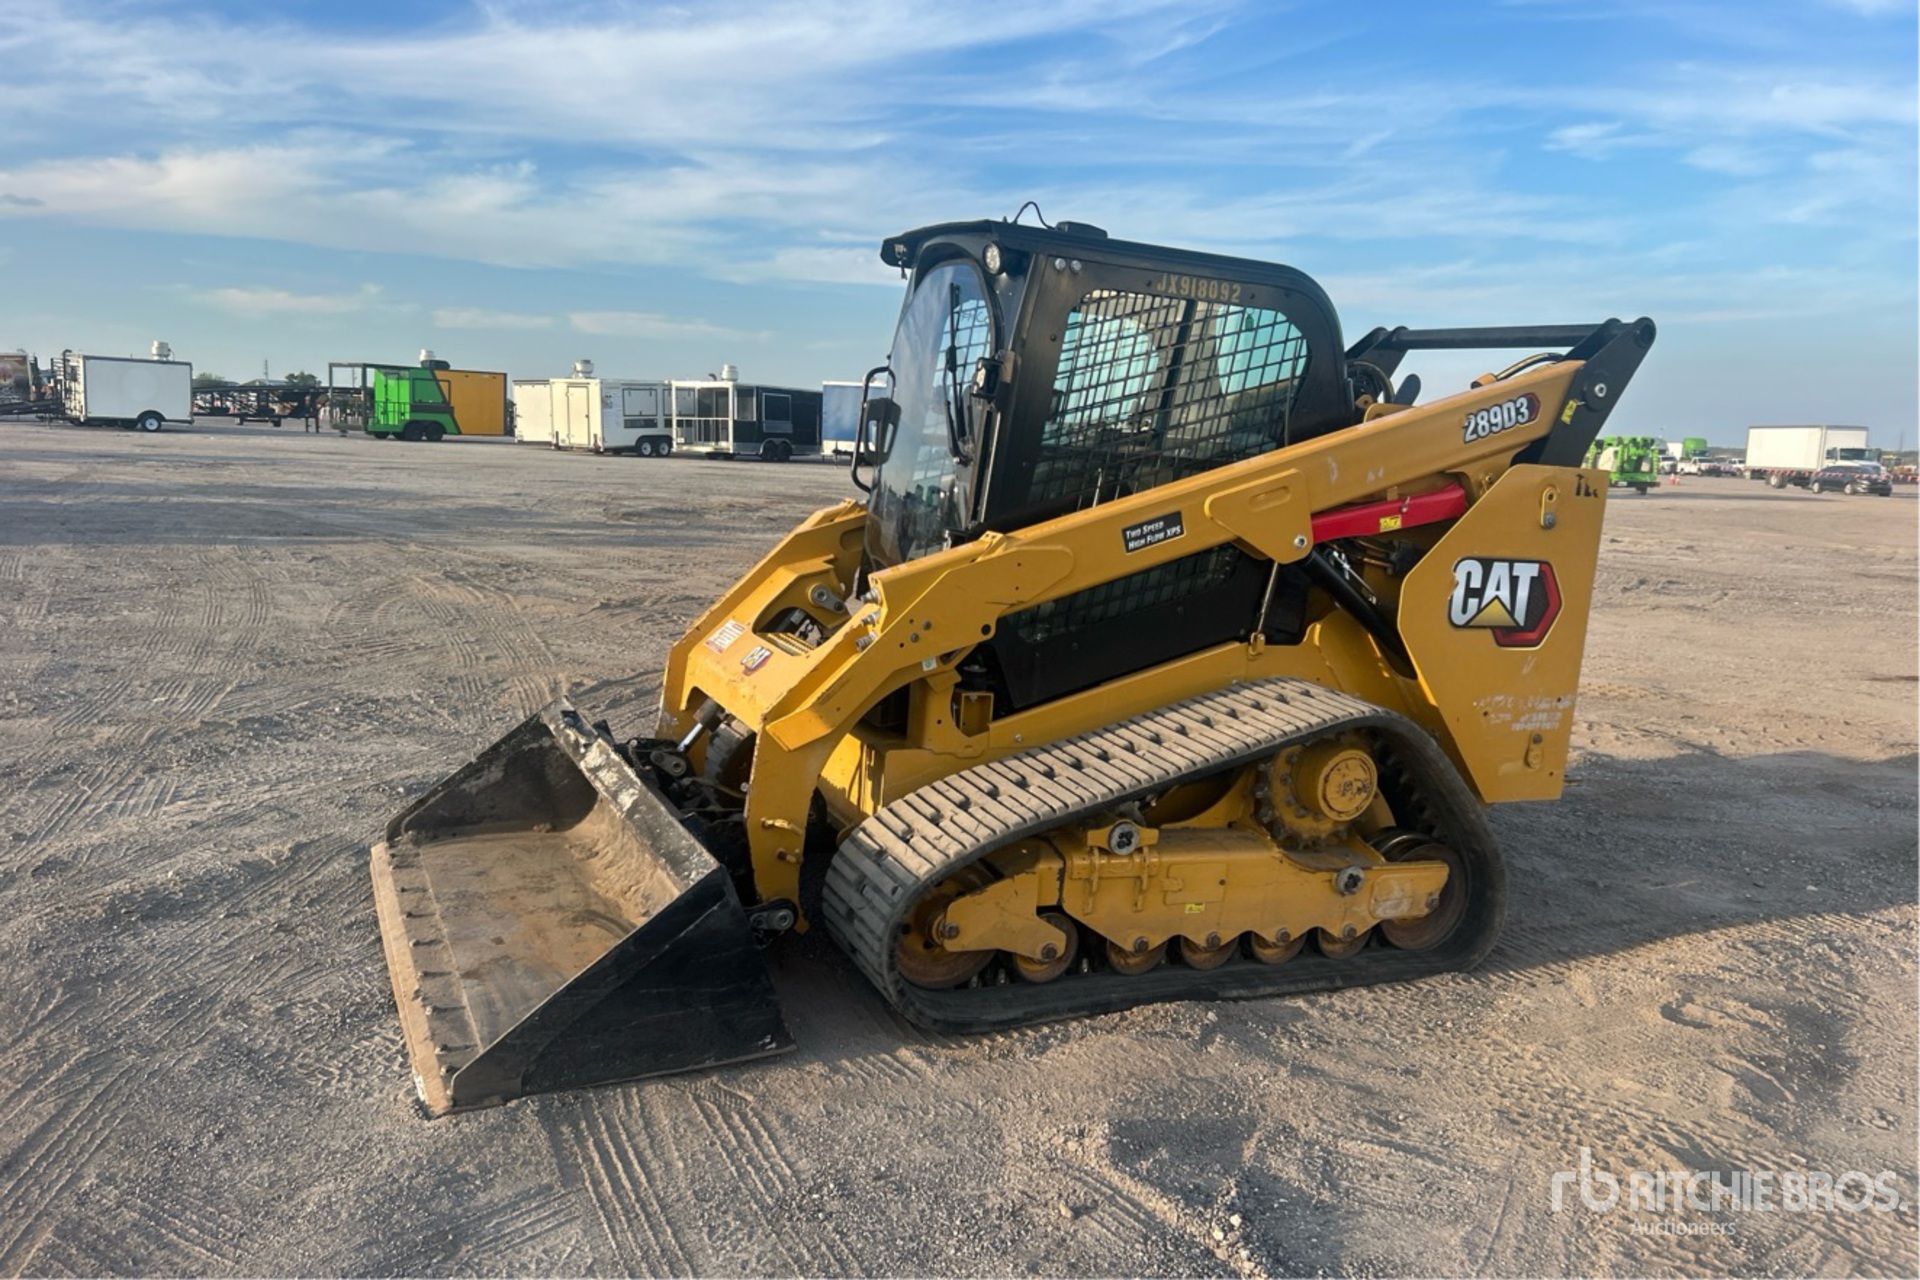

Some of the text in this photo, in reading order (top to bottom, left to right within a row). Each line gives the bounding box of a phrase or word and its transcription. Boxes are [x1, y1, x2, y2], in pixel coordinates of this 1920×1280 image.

[1157, 273, 1242, 303] JX918092
[1464, 397, 1530, 443] 289D3
[1166, 525, 1182, 538] XPS
[1449, 558, 1540, 627] CAT
